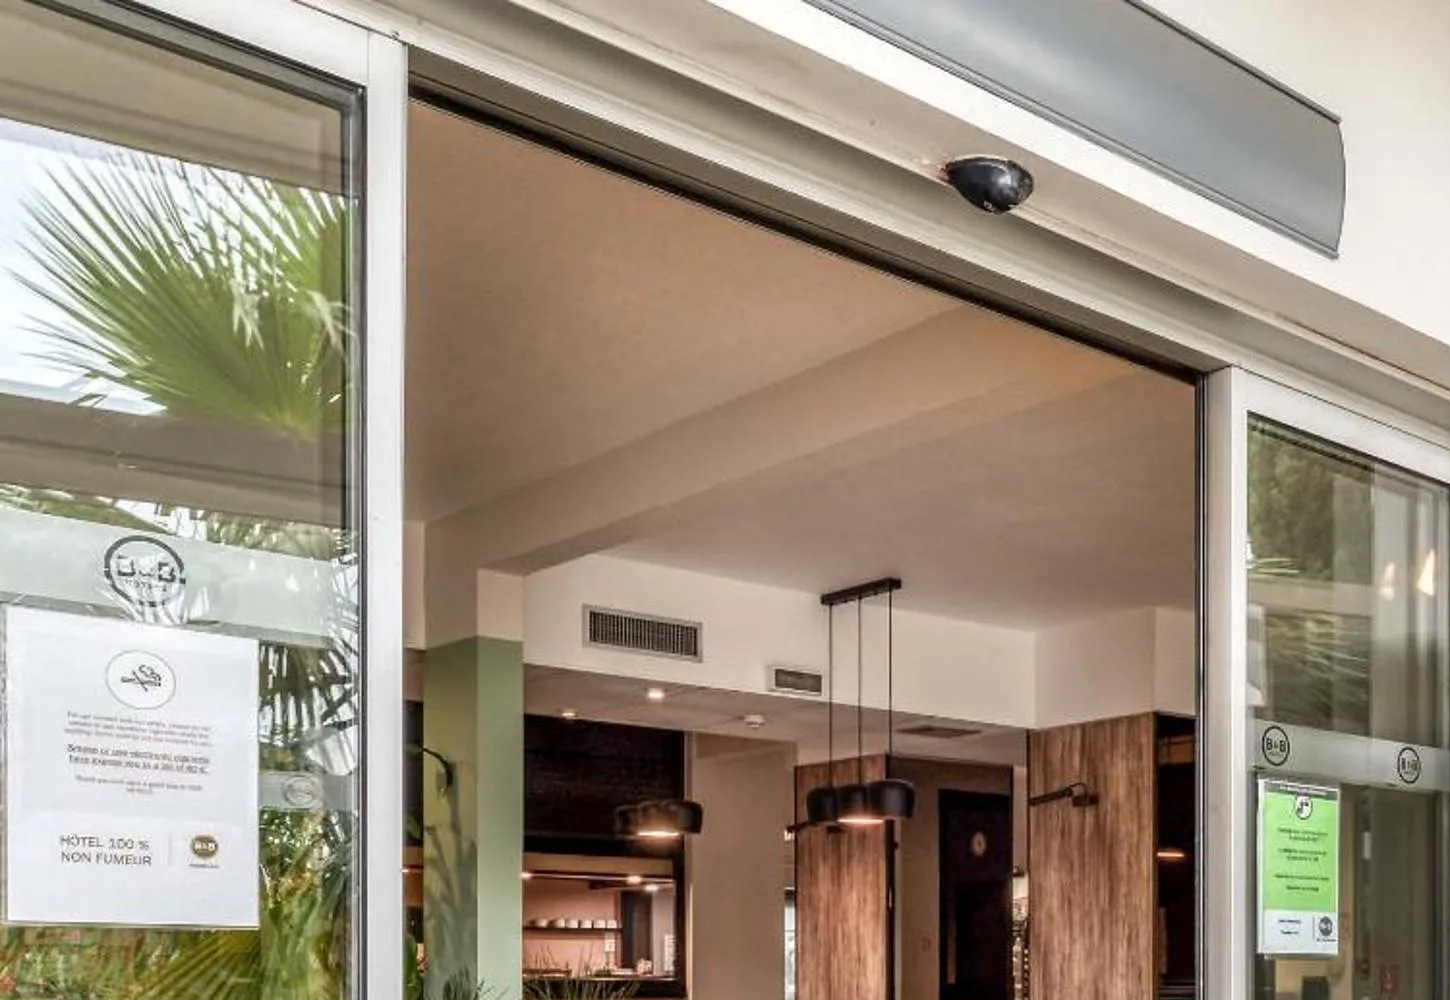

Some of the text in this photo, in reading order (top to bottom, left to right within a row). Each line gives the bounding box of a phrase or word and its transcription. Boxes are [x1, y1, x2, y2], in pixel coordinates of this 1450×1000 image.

[109, 837, 134, 851] 100
[138, 839, 150, 852] %
[61, 851, 152, 867] NON FUMEUR
